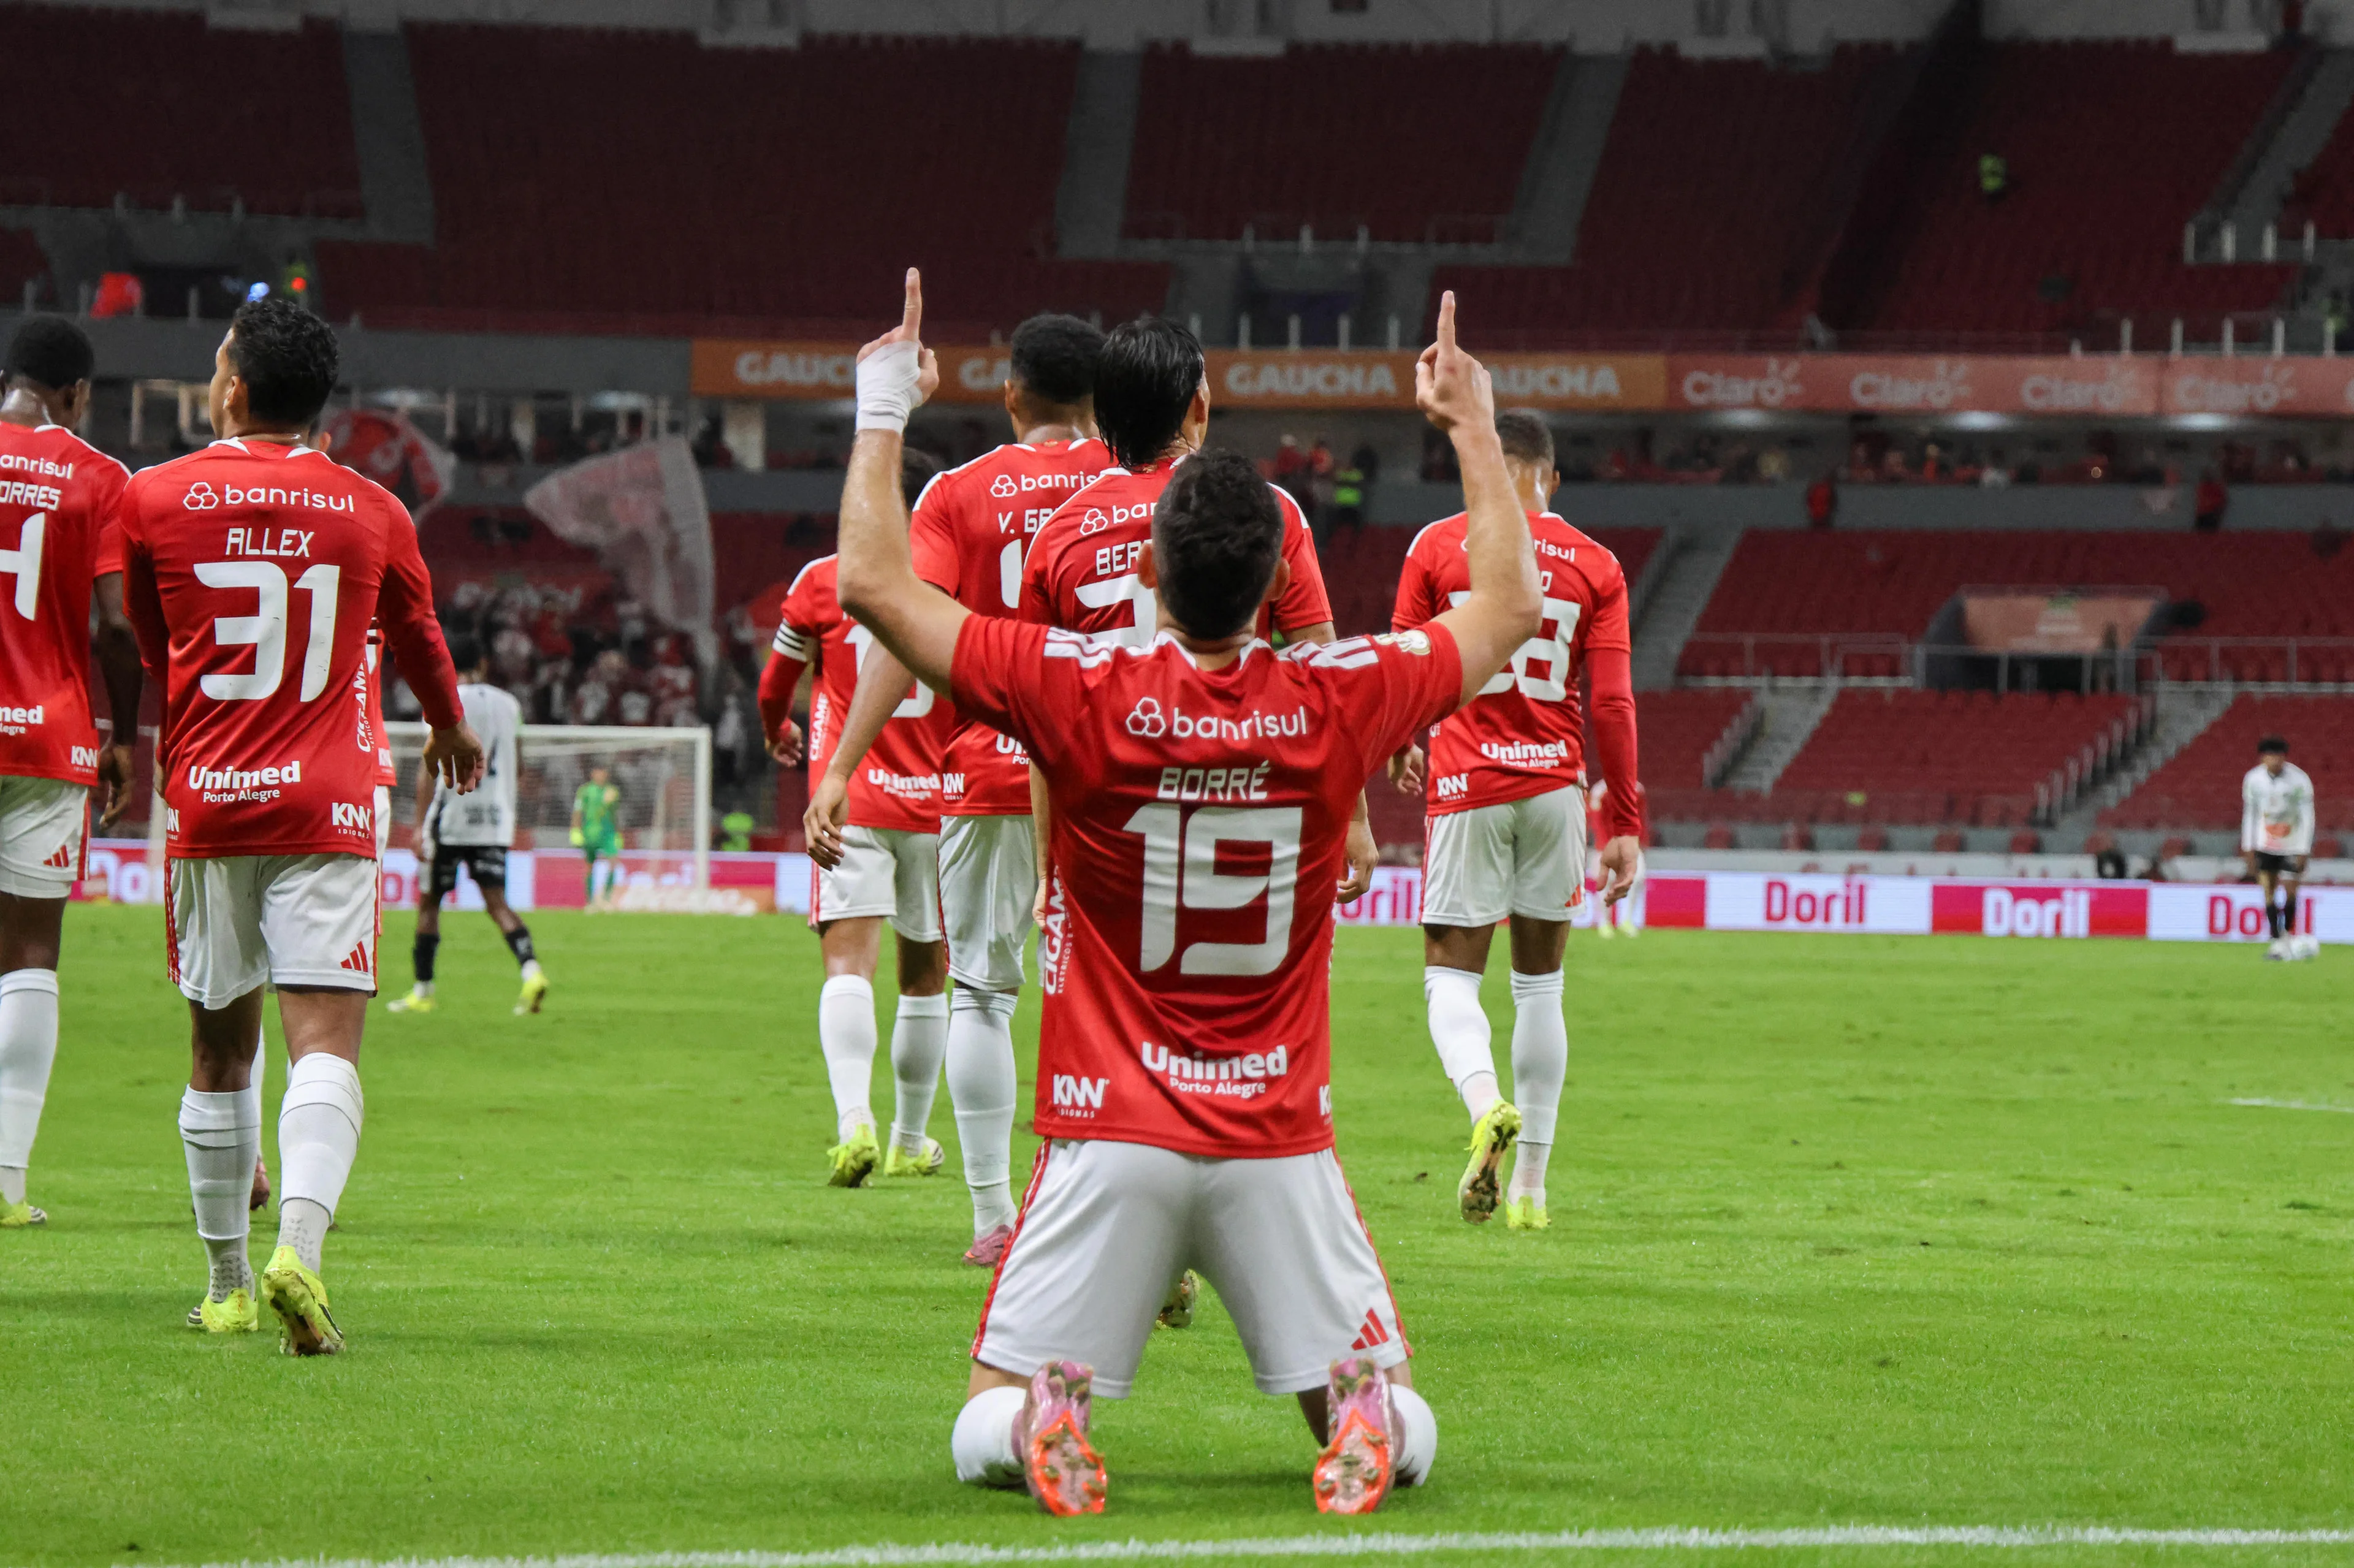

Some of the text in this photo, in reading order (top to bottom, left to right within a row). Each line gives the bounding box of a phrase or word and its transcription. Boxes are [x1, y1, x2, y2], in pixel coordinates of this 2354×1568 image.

[737, 352, 856, 386] GAUC
[1490, 365, 1619, 397] AUCHA
[0, 454, 73, 479] anrisul
[1021, 471, 1097, 491] banris
[0, 480, 62, 511] ORRES
[225, 484, 354, 512] banrisul
[226, 528, 314, 557] ALLEX
[1533, 539, 1575, 562] risul
[194, 561, 340, 702] 31
[1173, 706, 1307, 740] banrisul
[1480, 740, 1568, 760] Unimed
[188, 761, 301, 790] Unimed
[1157, 760, 1271, 801] BORRÉ
[203, 789, 280, 803] Porto Alegre
[1123, 802, 1302, 976] 19
[1341, 877, 1414, 919] oril
[1766, 880, 1865, 924] Doril
[1983, 888, 2090, 938] Doril
[2209, 896, 2312, 935] Dol
[1141, 1041, 1287, 1080] Unimed
[1170, 1076, 1266, 1099] Porto Alegre
